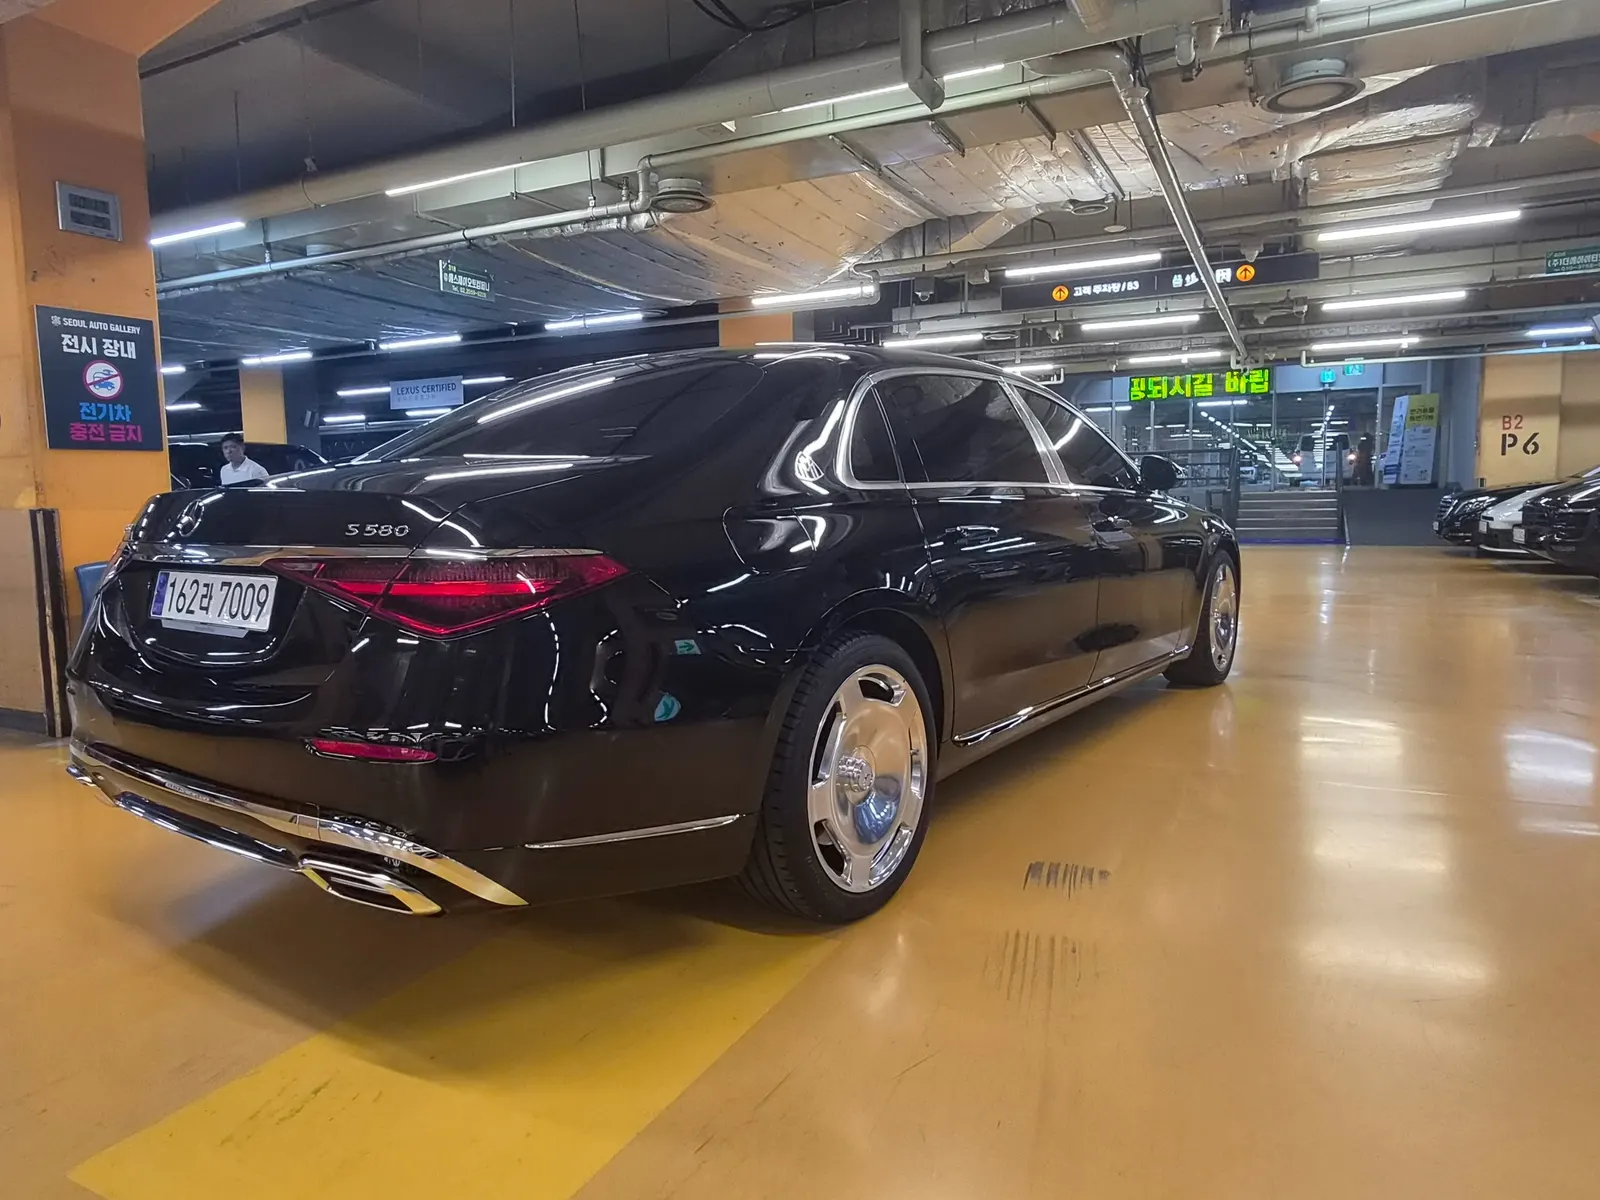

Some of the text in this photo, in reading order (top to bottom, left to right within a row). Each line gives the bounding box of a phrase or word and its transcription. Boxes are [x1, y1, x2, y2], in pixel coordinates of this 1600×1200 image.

[62, 317, 141, 335] SEOUL AUTO GALLERY
[61, 333, 137, 359] 전시 장내
[397, 382, 457, 396] LEXUS CERTIFIED
[79, 402, 131, 422] 전기차
[1502, 415, 1523, 430] B2
[69, 422, 143, 442] 충전 금지
[345, 524, 410, 537] S 580
